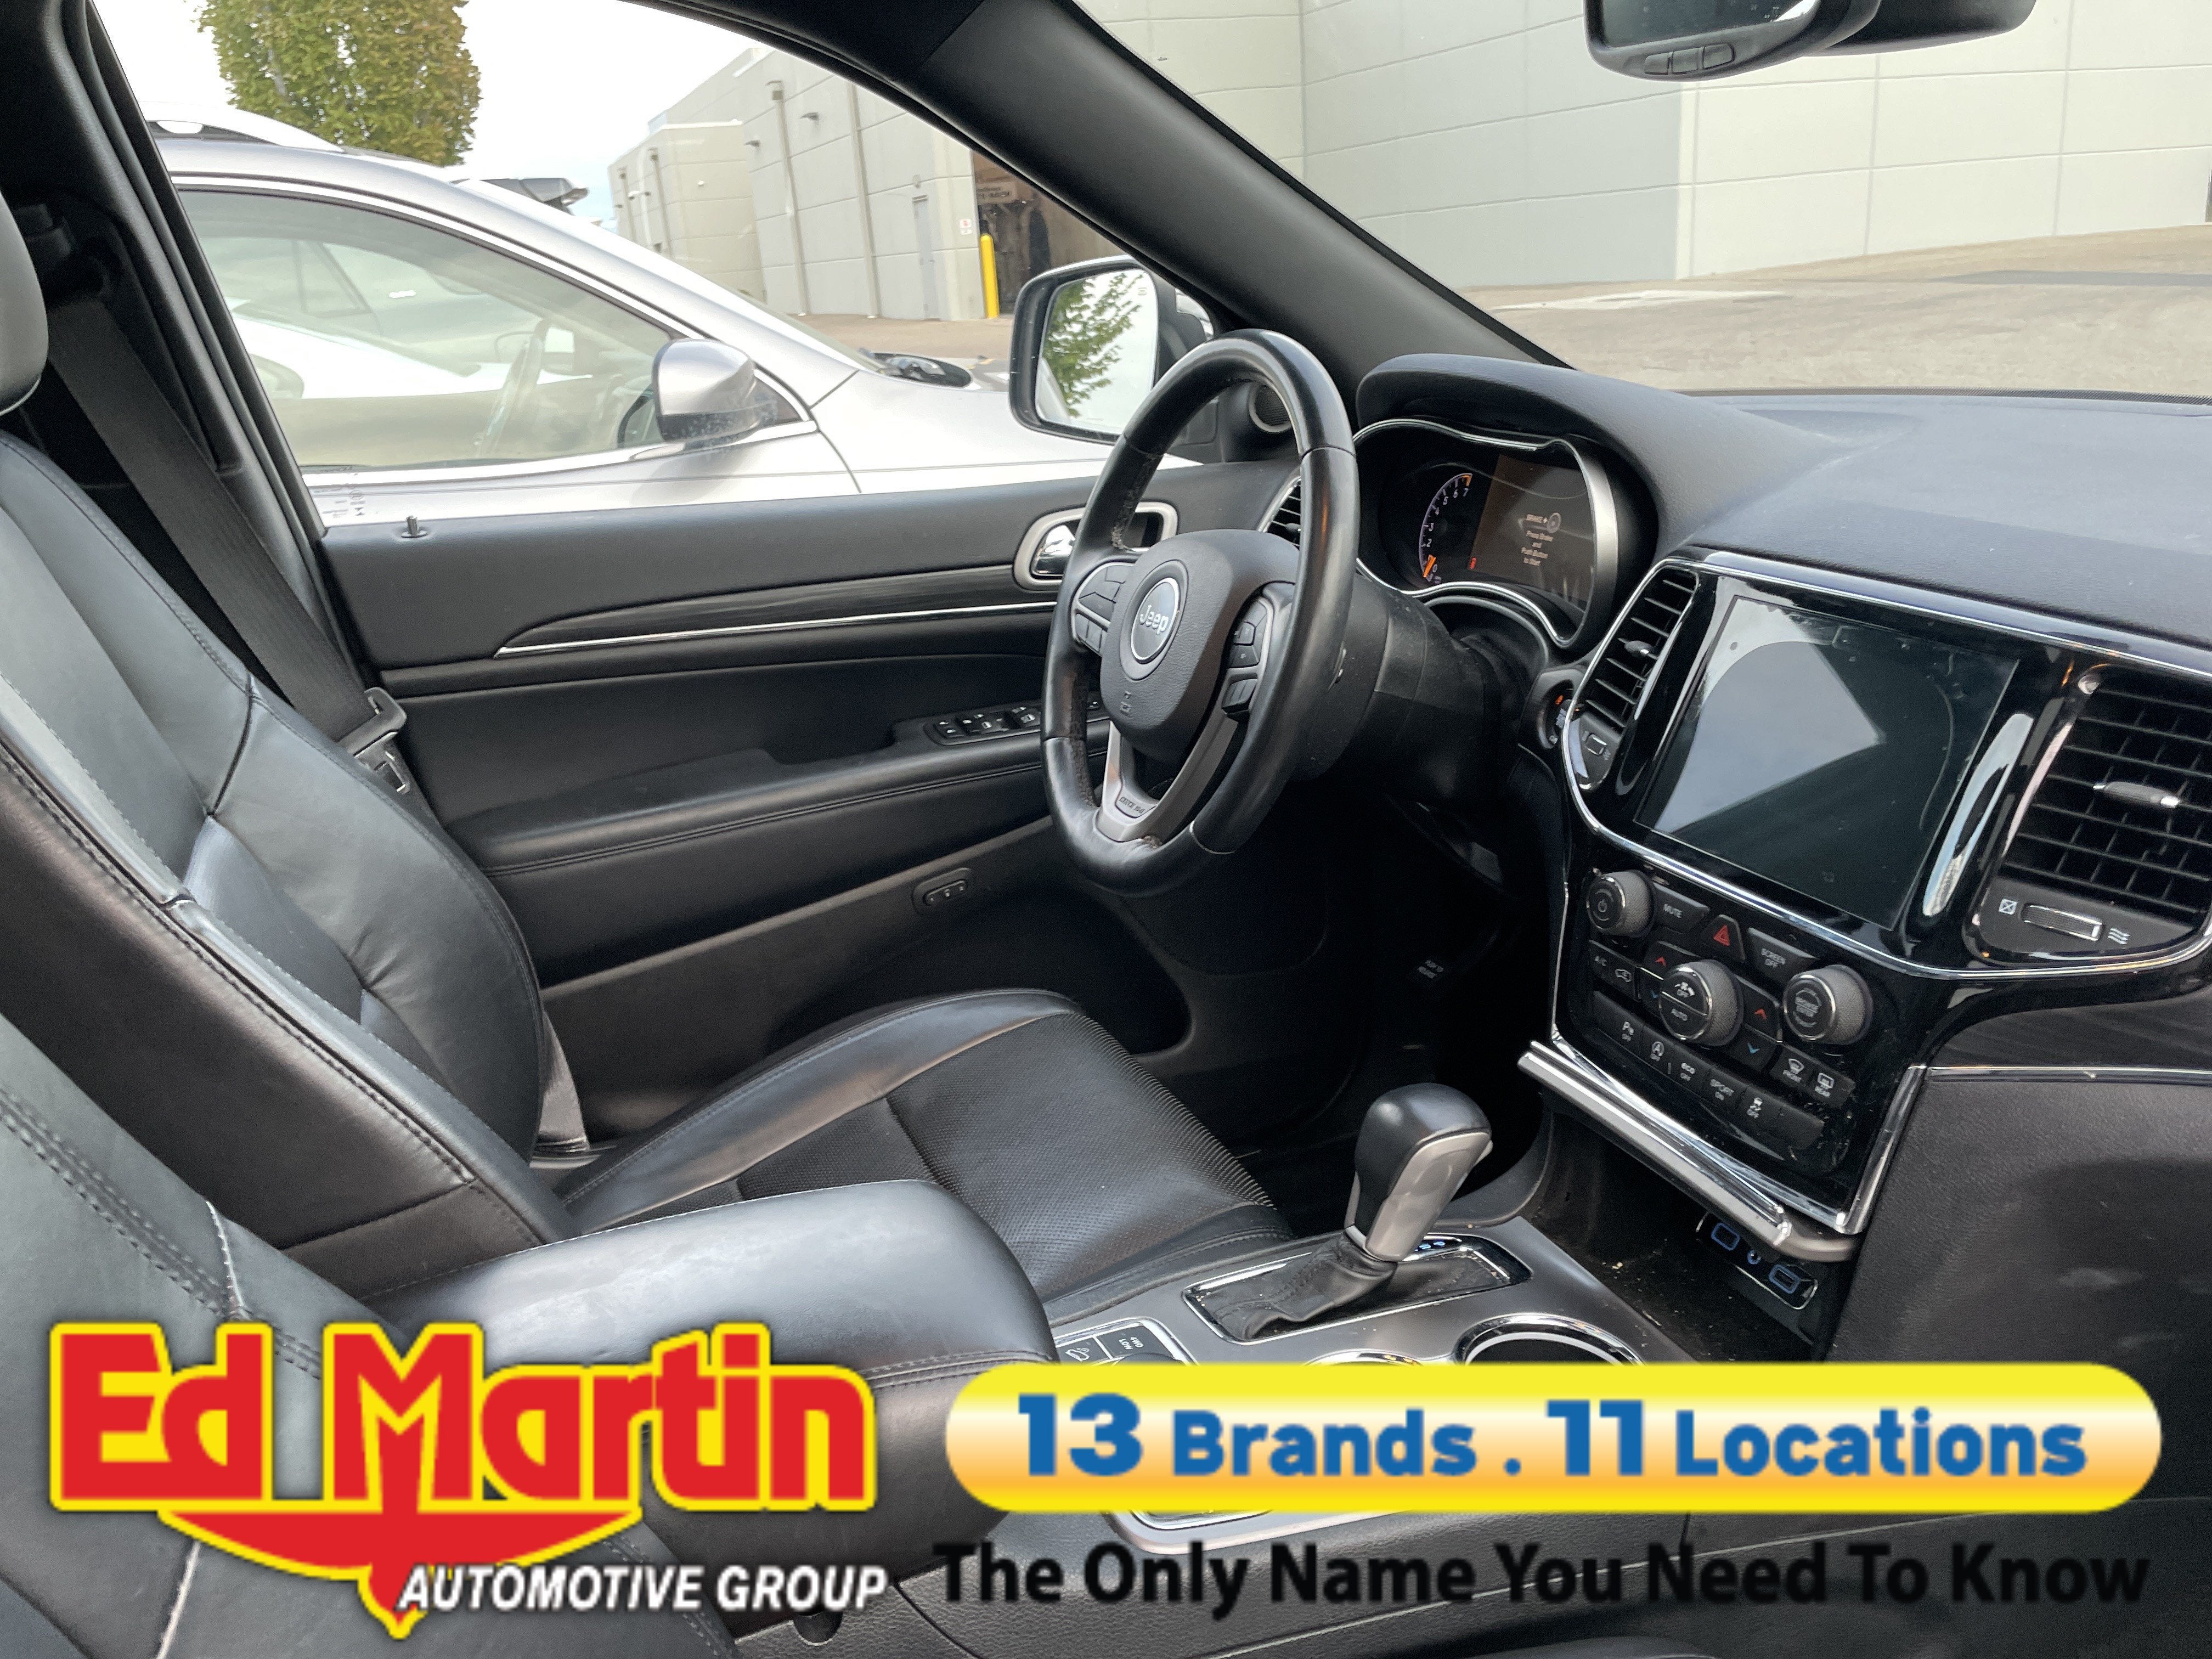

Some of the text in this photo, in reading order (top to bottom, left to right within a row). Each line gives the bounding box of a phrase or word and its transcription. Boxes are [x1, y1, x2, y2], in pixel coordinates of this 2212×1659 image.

[1453, 489, 1459, 498] 6
[1443, 496, 1449, 505] 5
[1426, 539, 1432, 548] 2
[1140, 605, 1169, 635] Jeep
[1663, 904, 1682, 919] MUTE
[1761, 948, 1786, 965] SCREEN
[1119, 1339, 1133, 1350] LOW
[1131, 1336, 1144, 1348] 4WD
